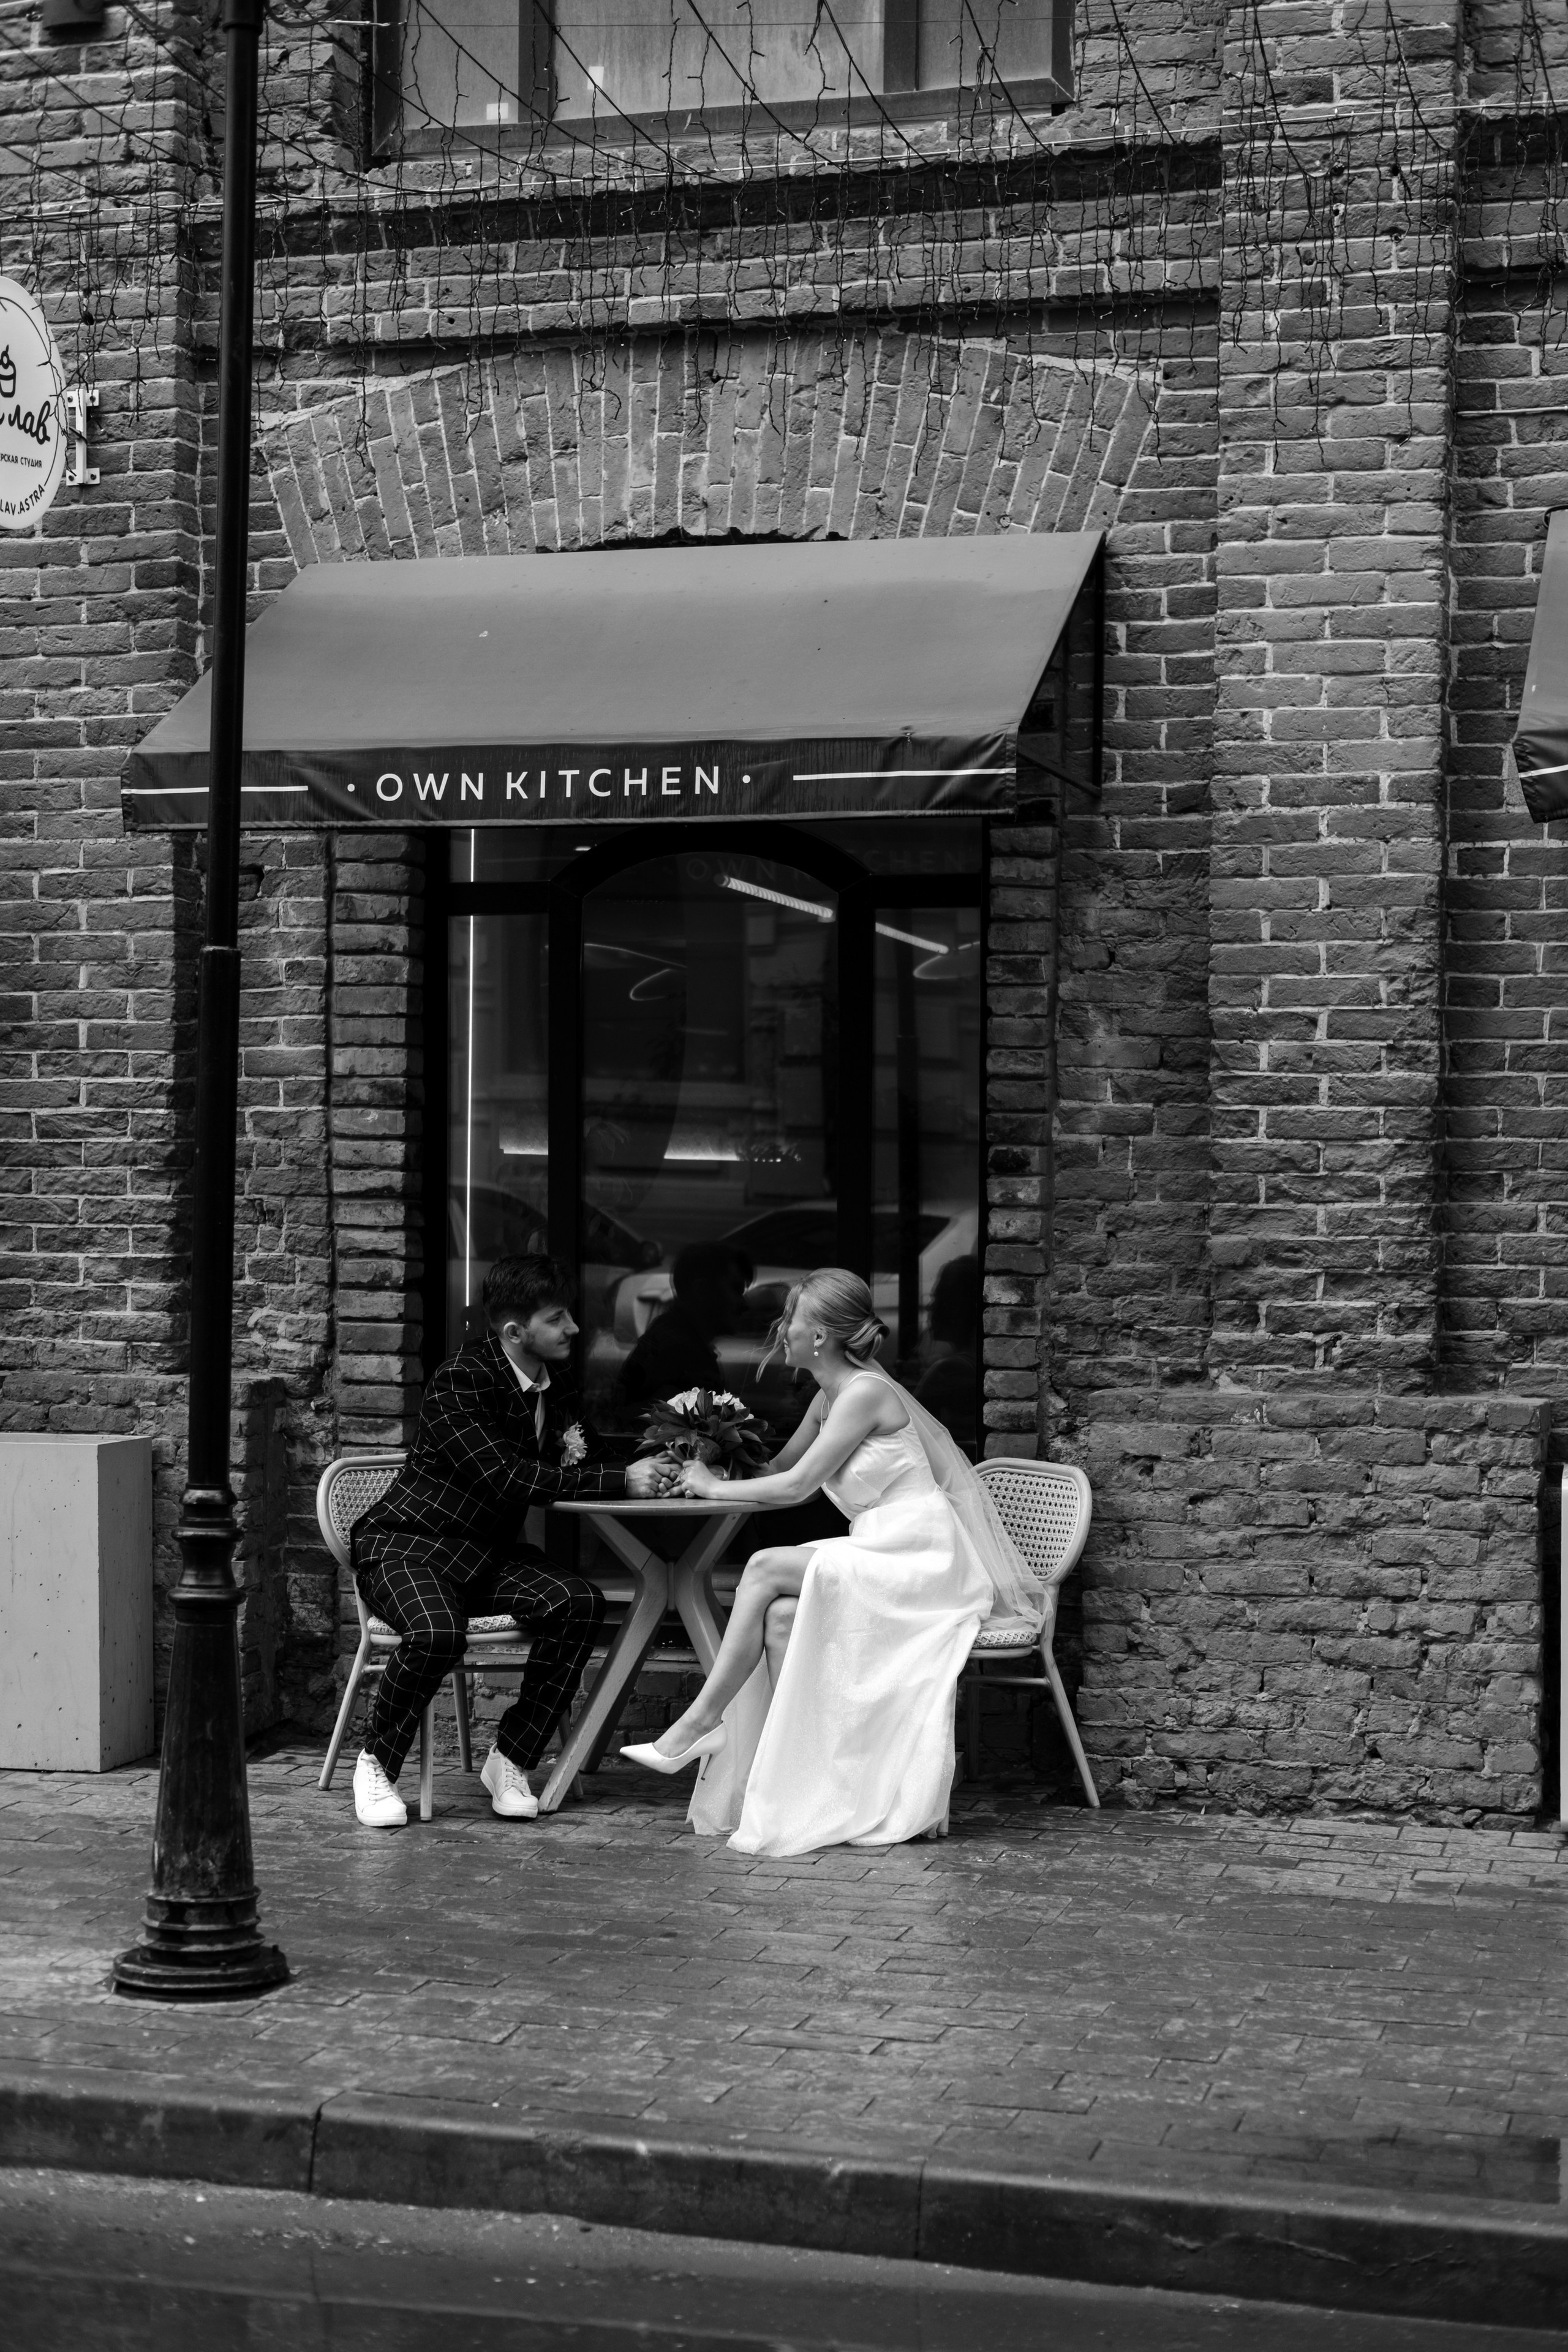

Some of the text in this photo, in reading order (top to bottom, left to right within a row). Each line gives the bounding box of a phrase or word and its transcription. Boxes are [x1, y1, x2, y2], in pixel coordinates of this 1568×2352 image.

[0, 453, 42, 468] РСКАЯ СТУДИЯ
[376, 766, 719, 801] OWN KITCHEN
